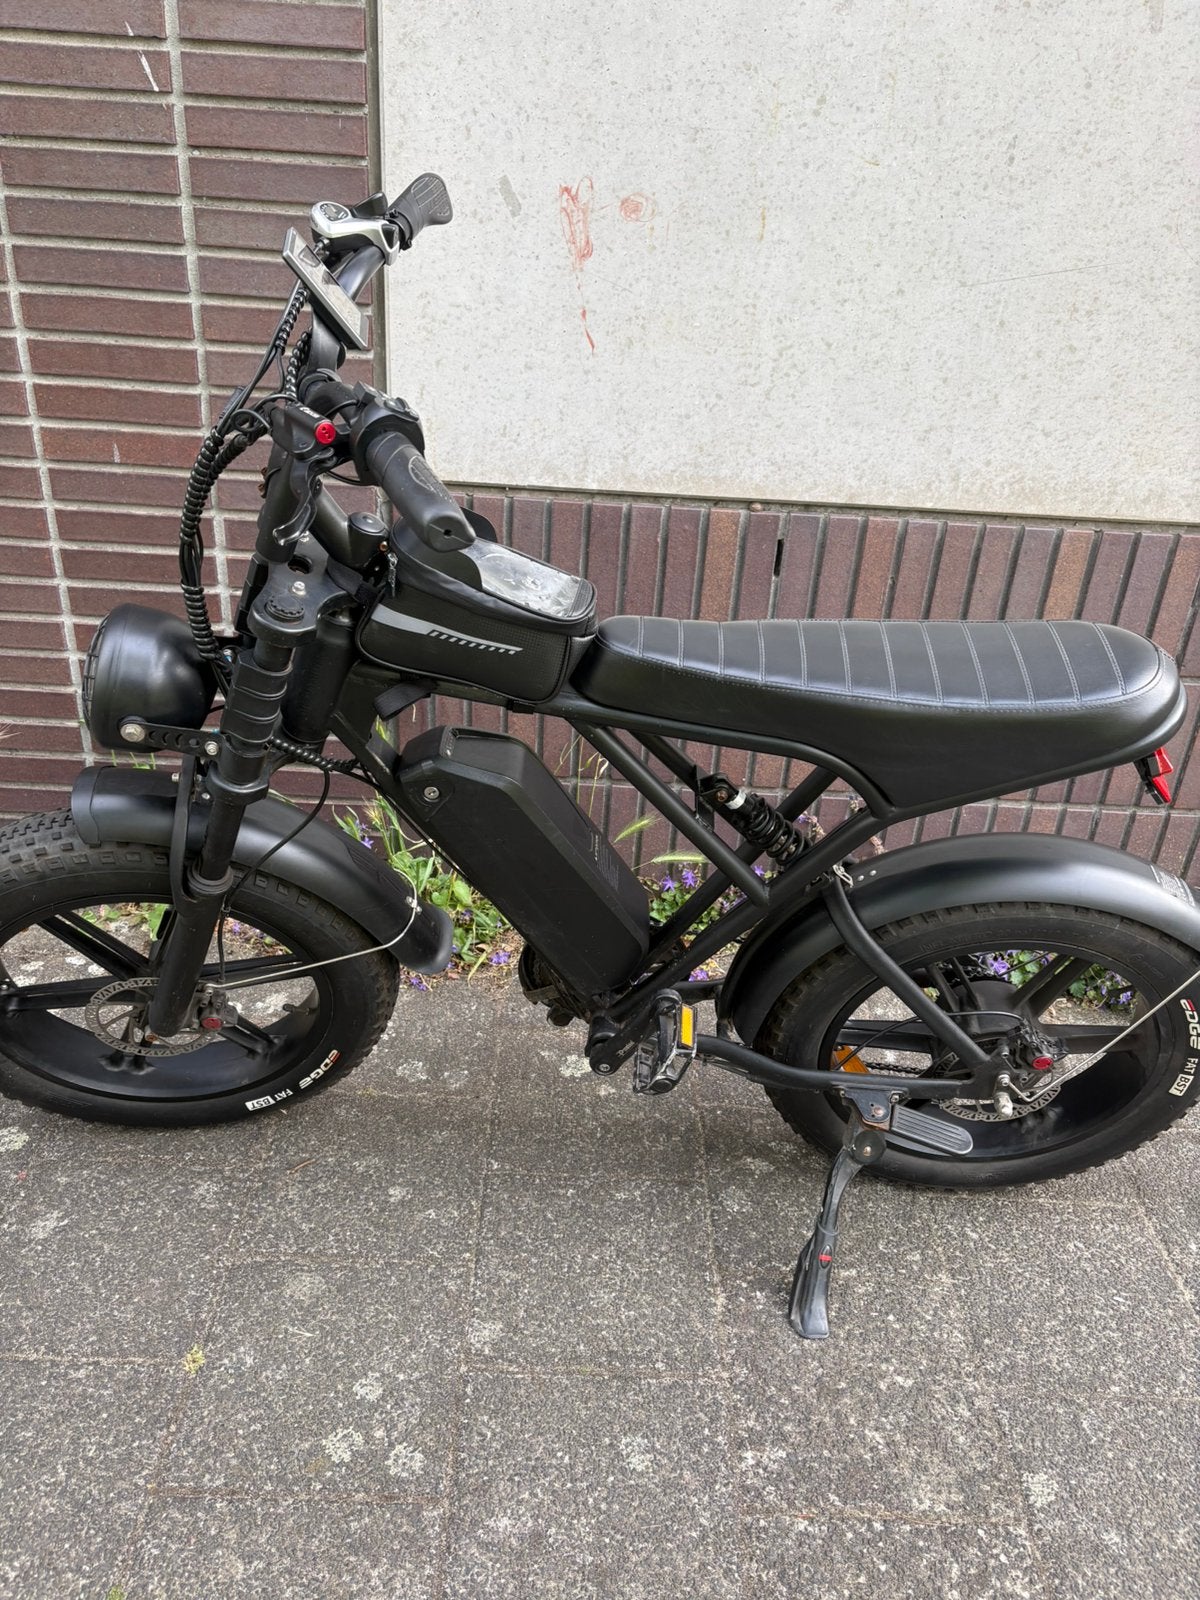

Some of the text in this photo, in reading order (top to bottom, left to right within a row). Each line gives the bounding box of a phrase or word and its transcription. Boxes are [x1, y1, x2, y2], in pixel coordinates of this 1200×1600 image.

[248, 1049, 341, 1110] EDGE FAT BST
[1173, 999, 1200, 1095] EDGE FAT BST
